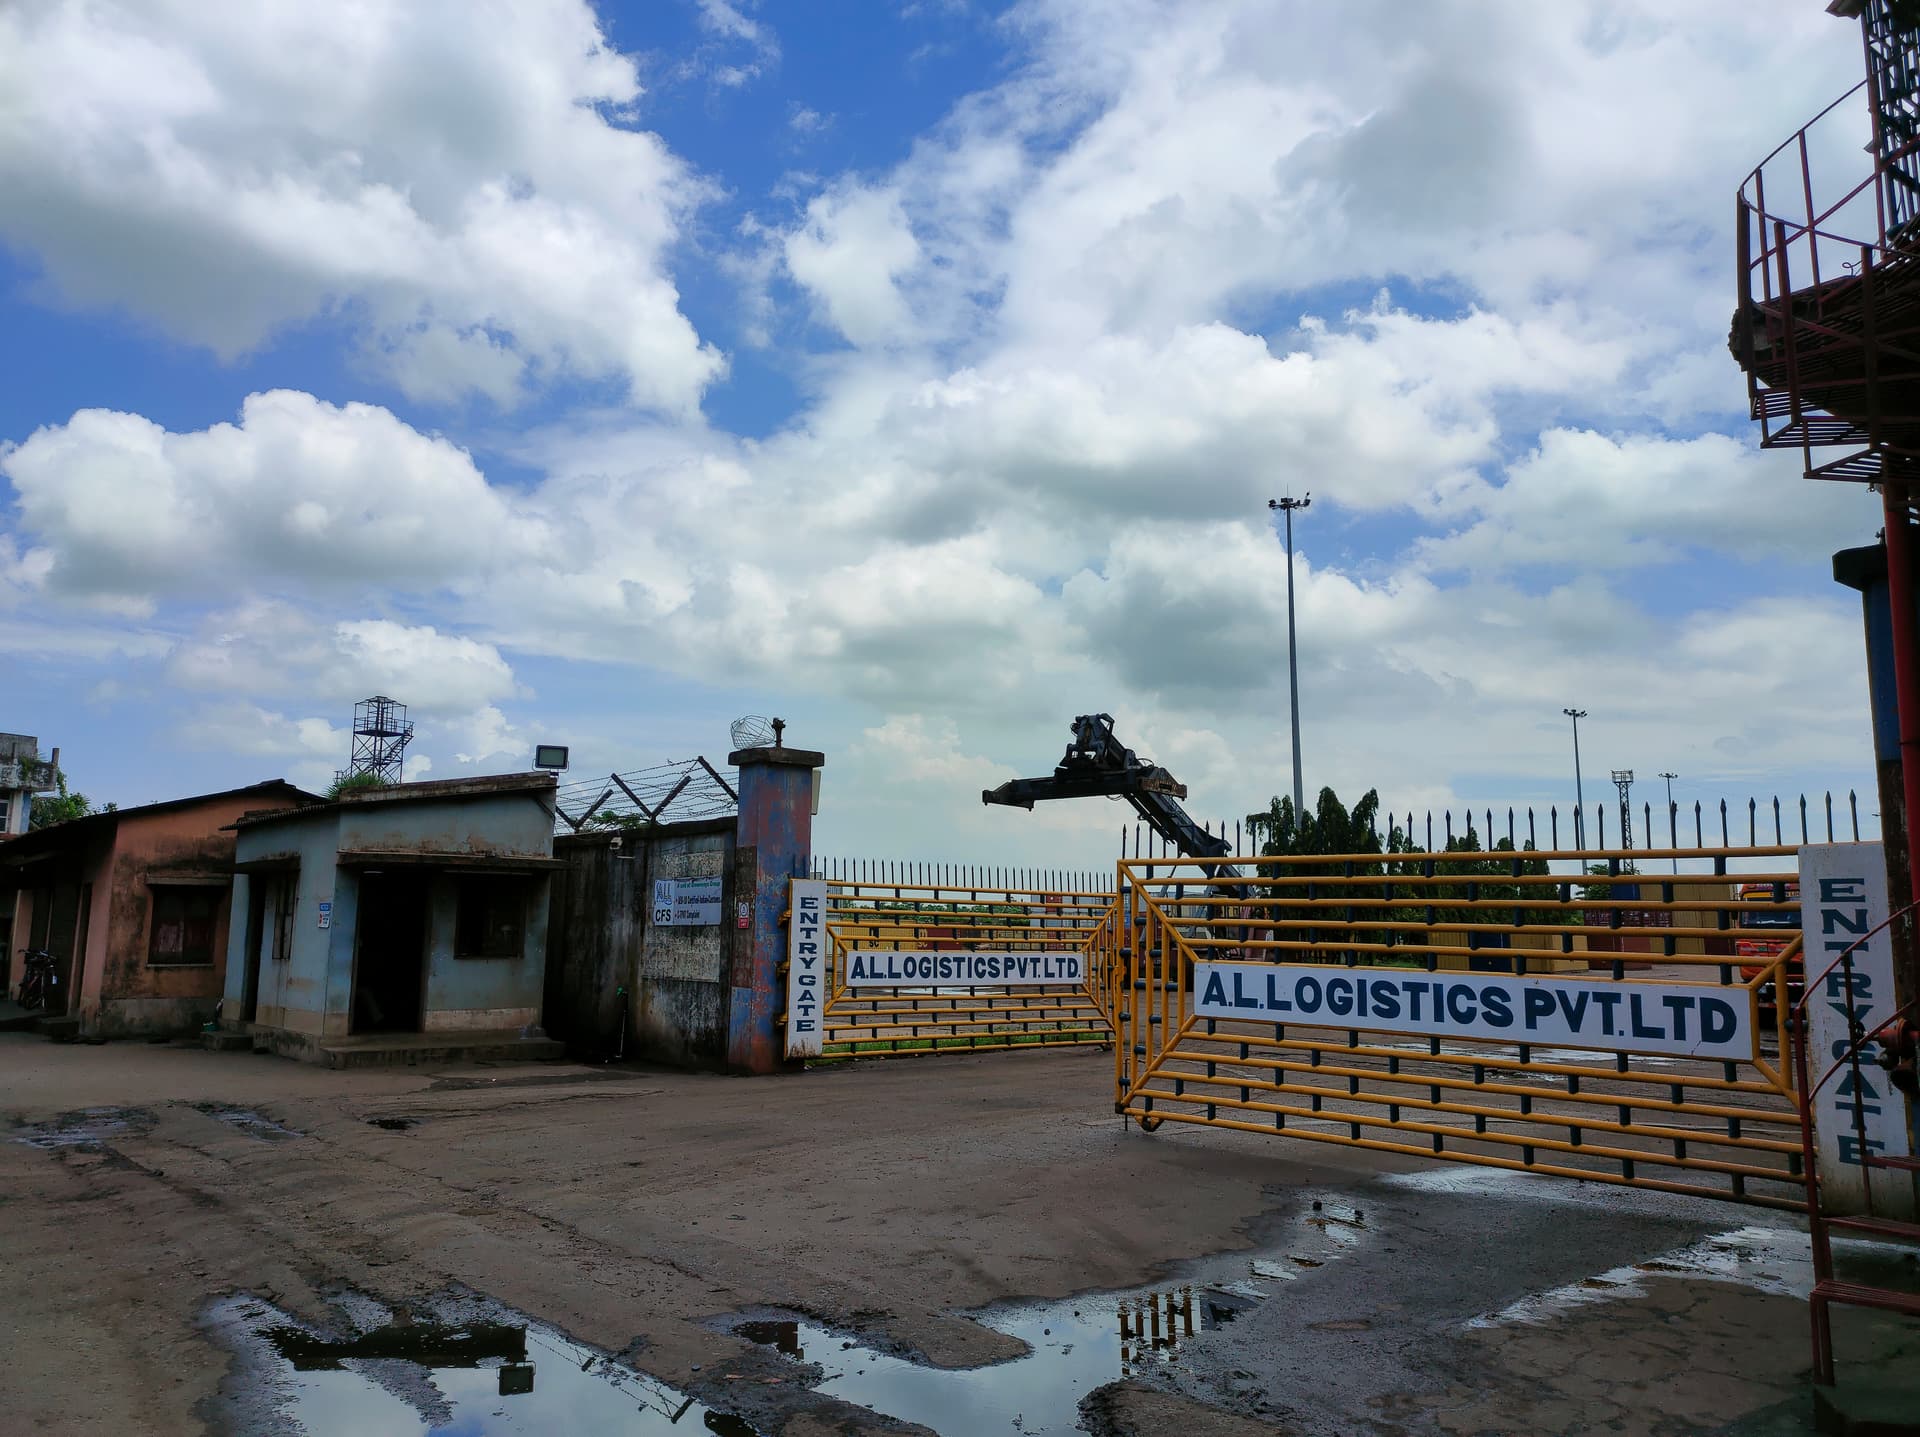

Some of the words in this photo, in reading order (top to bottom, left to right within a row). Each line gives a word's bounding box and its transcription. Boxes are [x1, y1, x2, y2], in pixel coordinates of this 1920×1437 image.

[655, 909, 671, 922] CFS
[798, 896, 819, 969] ENTRY
[1818, 878, 1874, 1029] ENTRY
[796, 975, 816, 1032] GATE
